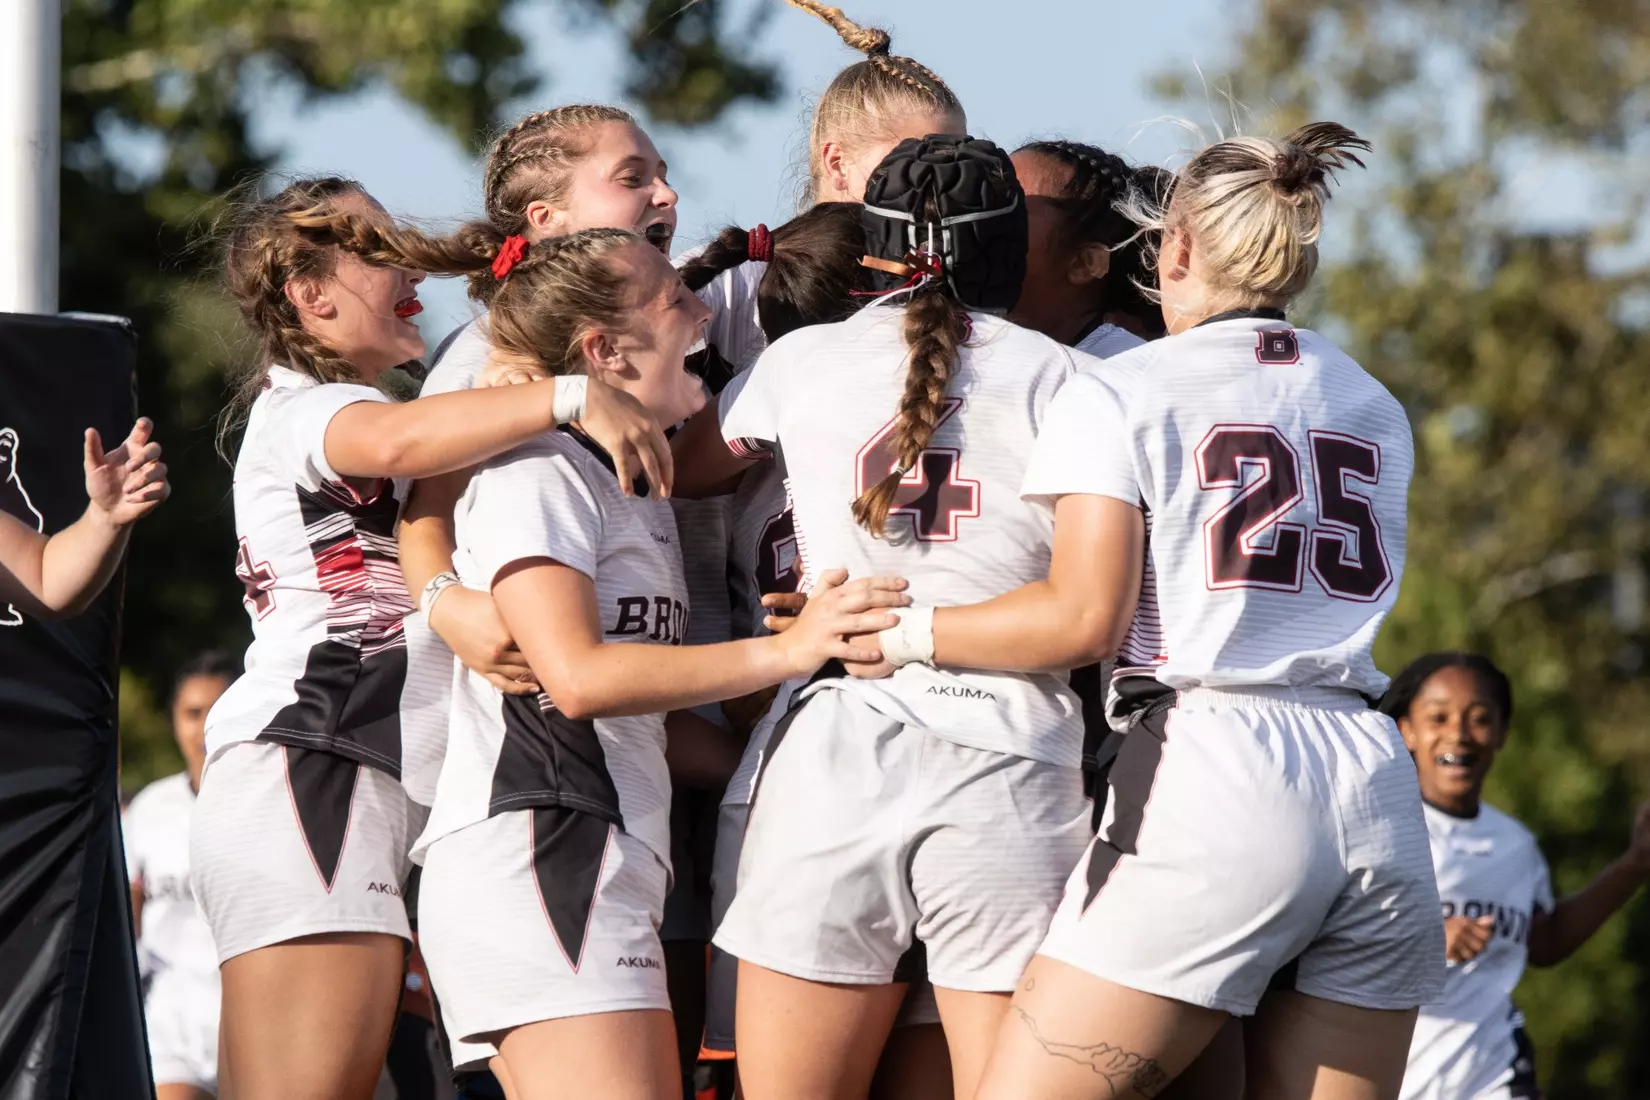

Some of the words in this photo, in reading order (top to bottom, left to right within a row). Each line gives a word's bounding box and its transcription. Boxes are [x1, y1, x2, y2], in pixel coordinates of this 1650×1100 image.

[856, 397, 981, 542] 4
[1194, 423, 1393, 603] 25
[925, 685, 997, 702] AKUMA
